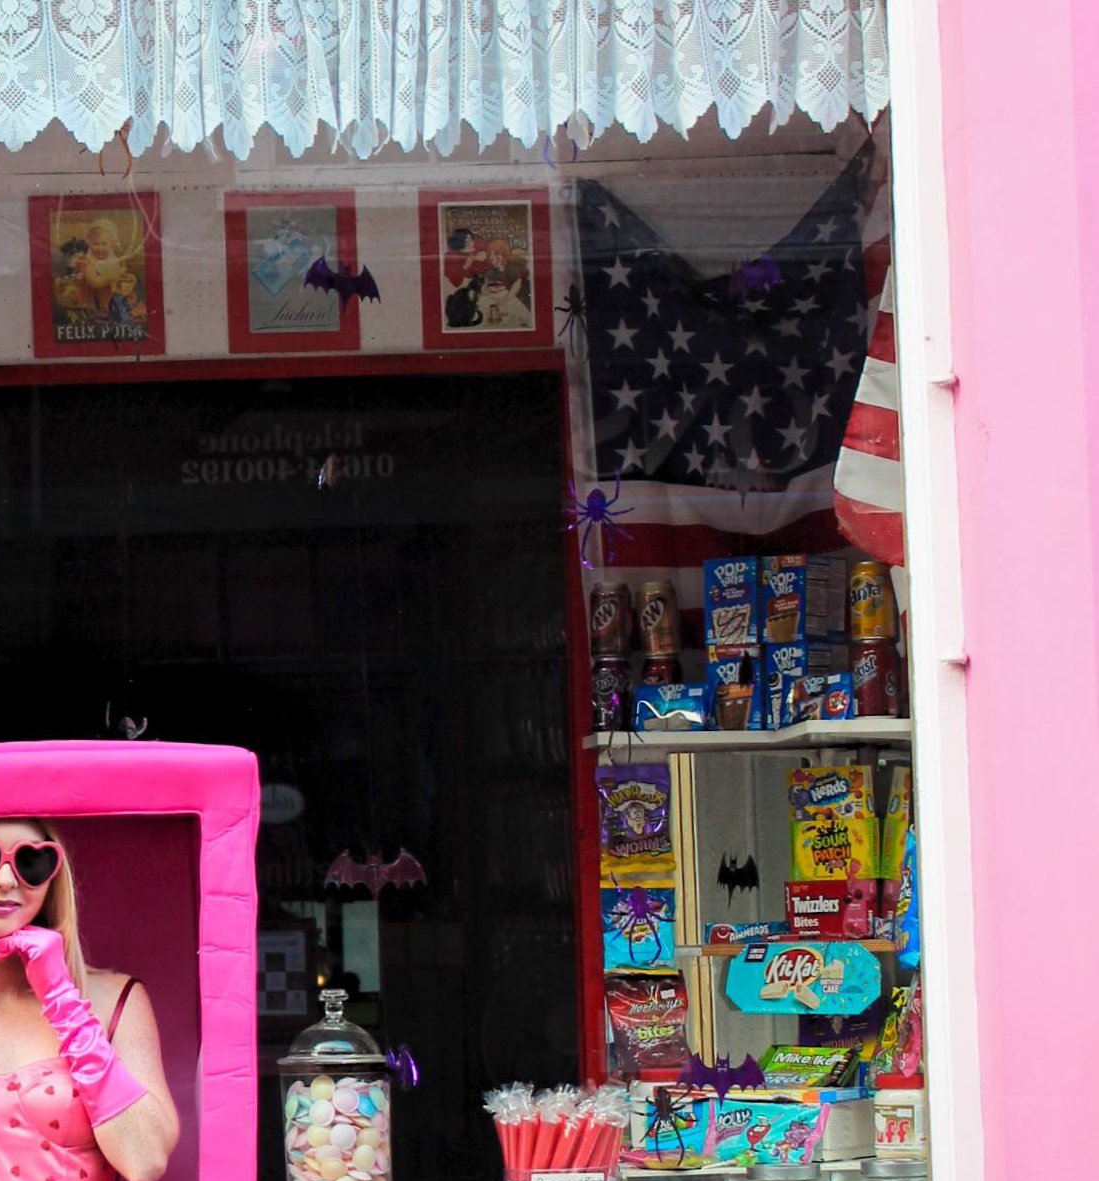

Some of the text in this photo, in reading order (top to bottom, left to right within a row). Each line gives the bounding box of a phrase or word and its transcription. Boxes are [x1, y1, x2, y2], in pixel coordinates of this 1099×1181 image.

[850, 583, 883, 604] anta
[614, 837, 668, 855] WORMS
[813, 831, 849, 849] SOUR
[813, 846, 851, 865] PATCH
[791, 896, 839, 914] Twizzlers
[794, 916, 819, 928] Bites
[821, 985, 840, 994] CAKE
[773, 1052, 811, 1065] Mike
